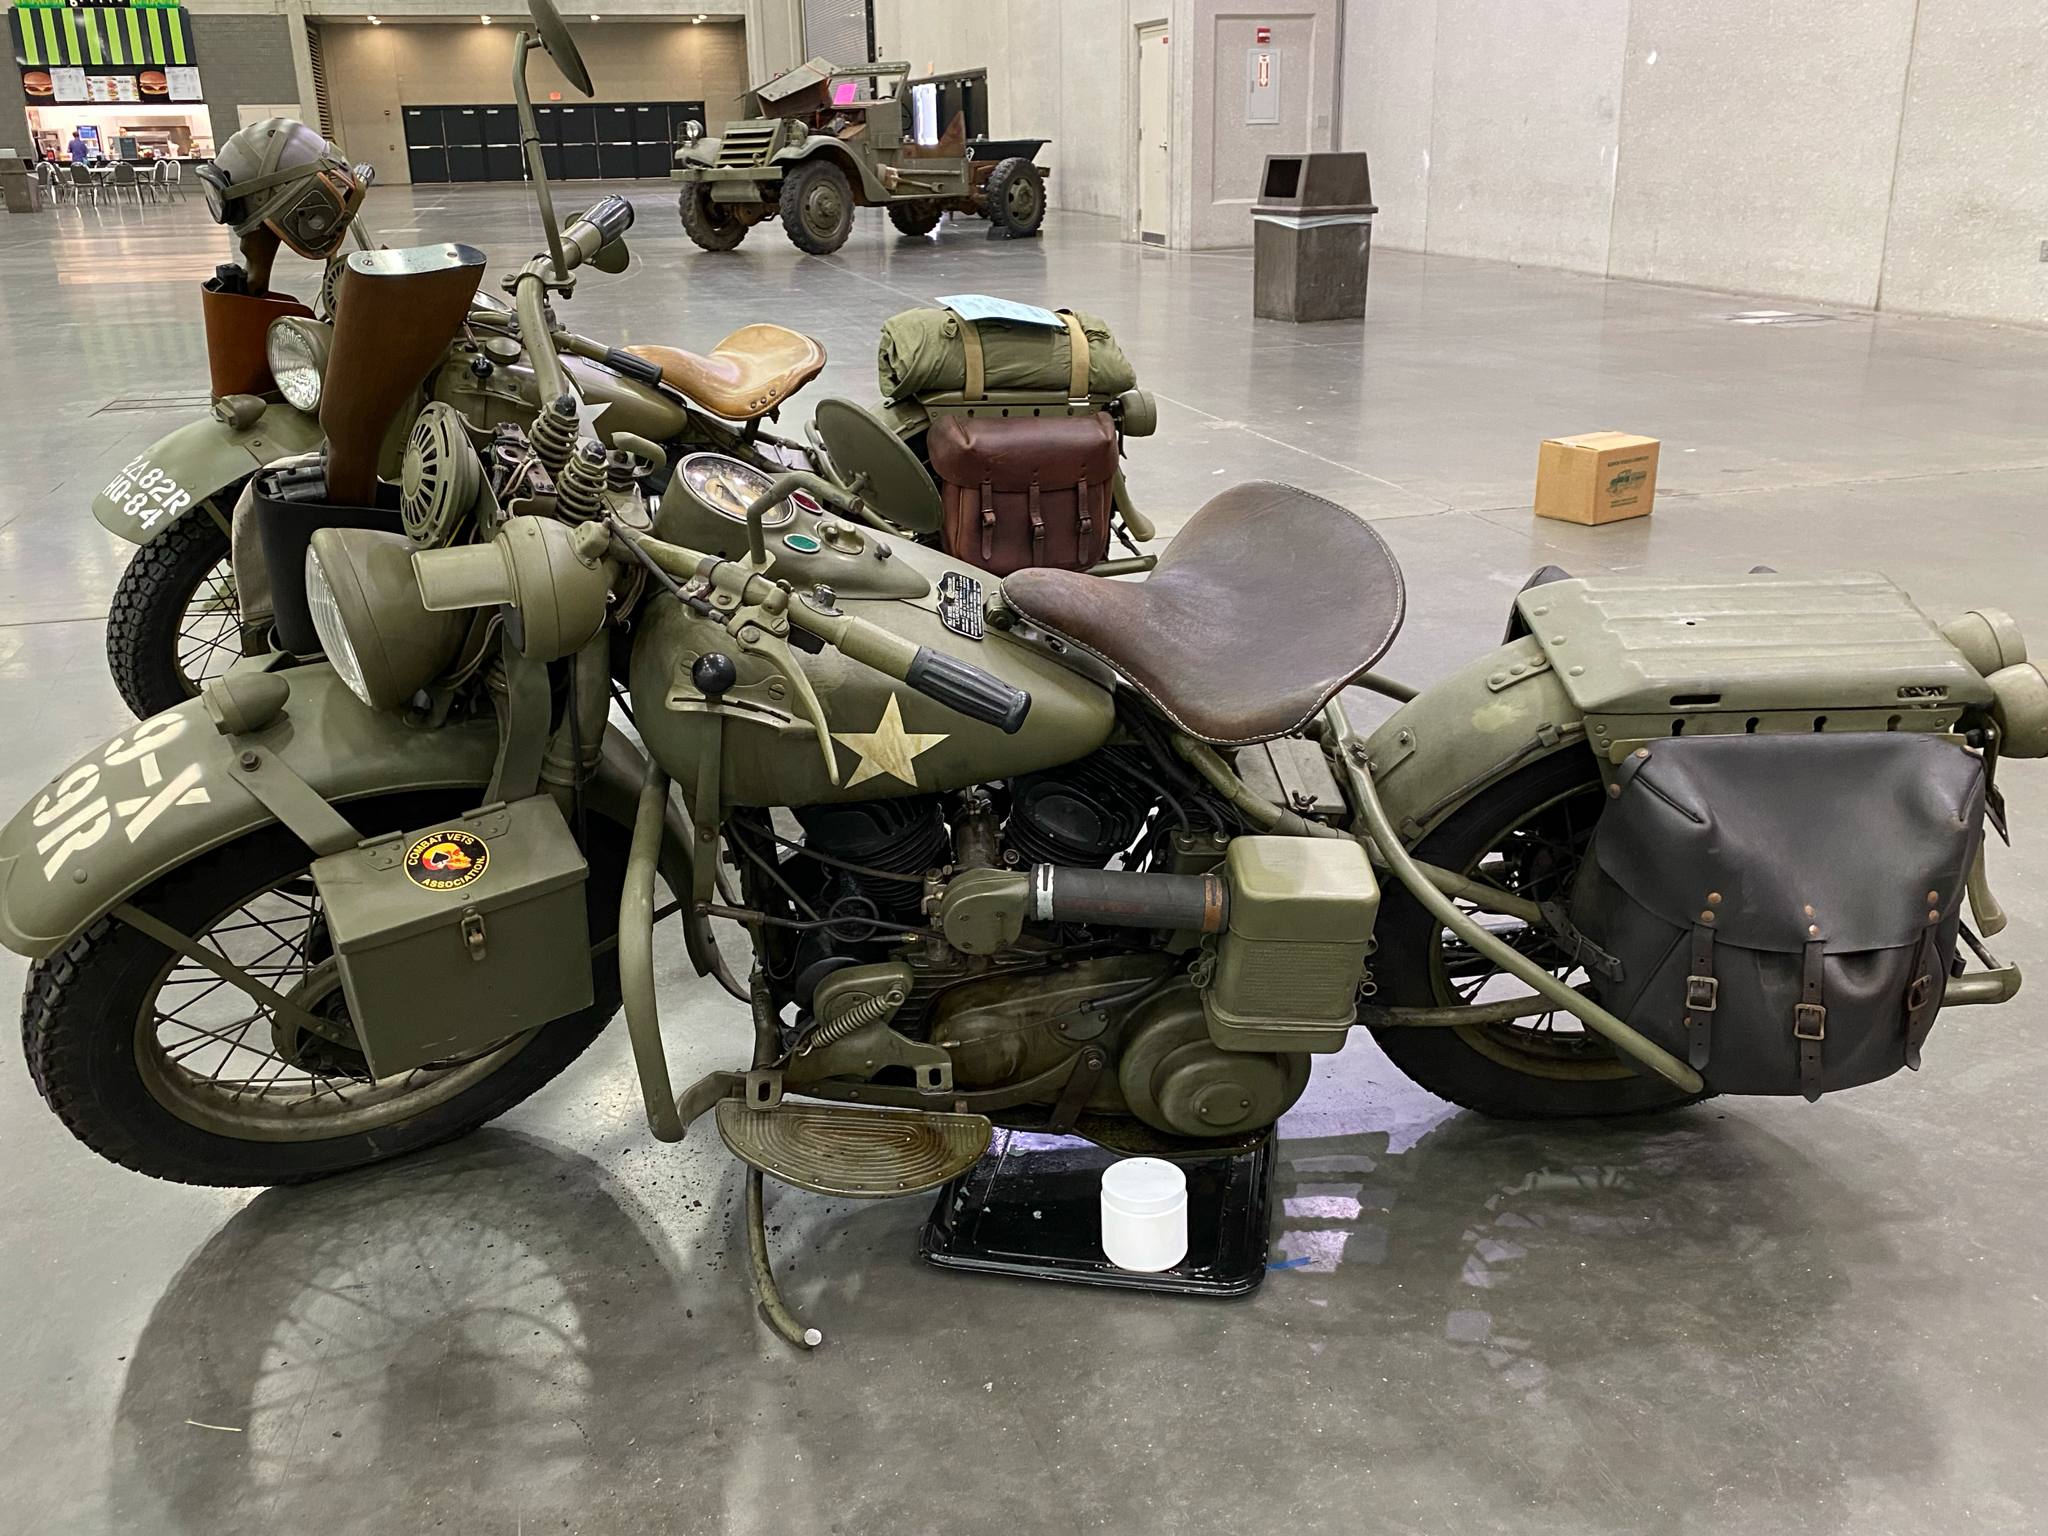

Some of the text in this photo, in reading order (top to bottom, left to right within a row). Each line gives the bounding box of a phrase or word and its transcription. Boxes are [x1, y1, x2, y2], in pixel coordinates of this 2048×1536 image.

[102, 474, 165, 530] HQ-84
[104, 712, 211, 843] 9-X
[33, 763, 111, 882] 9R
[408, 833, 475, 866] COMBAT VETS
